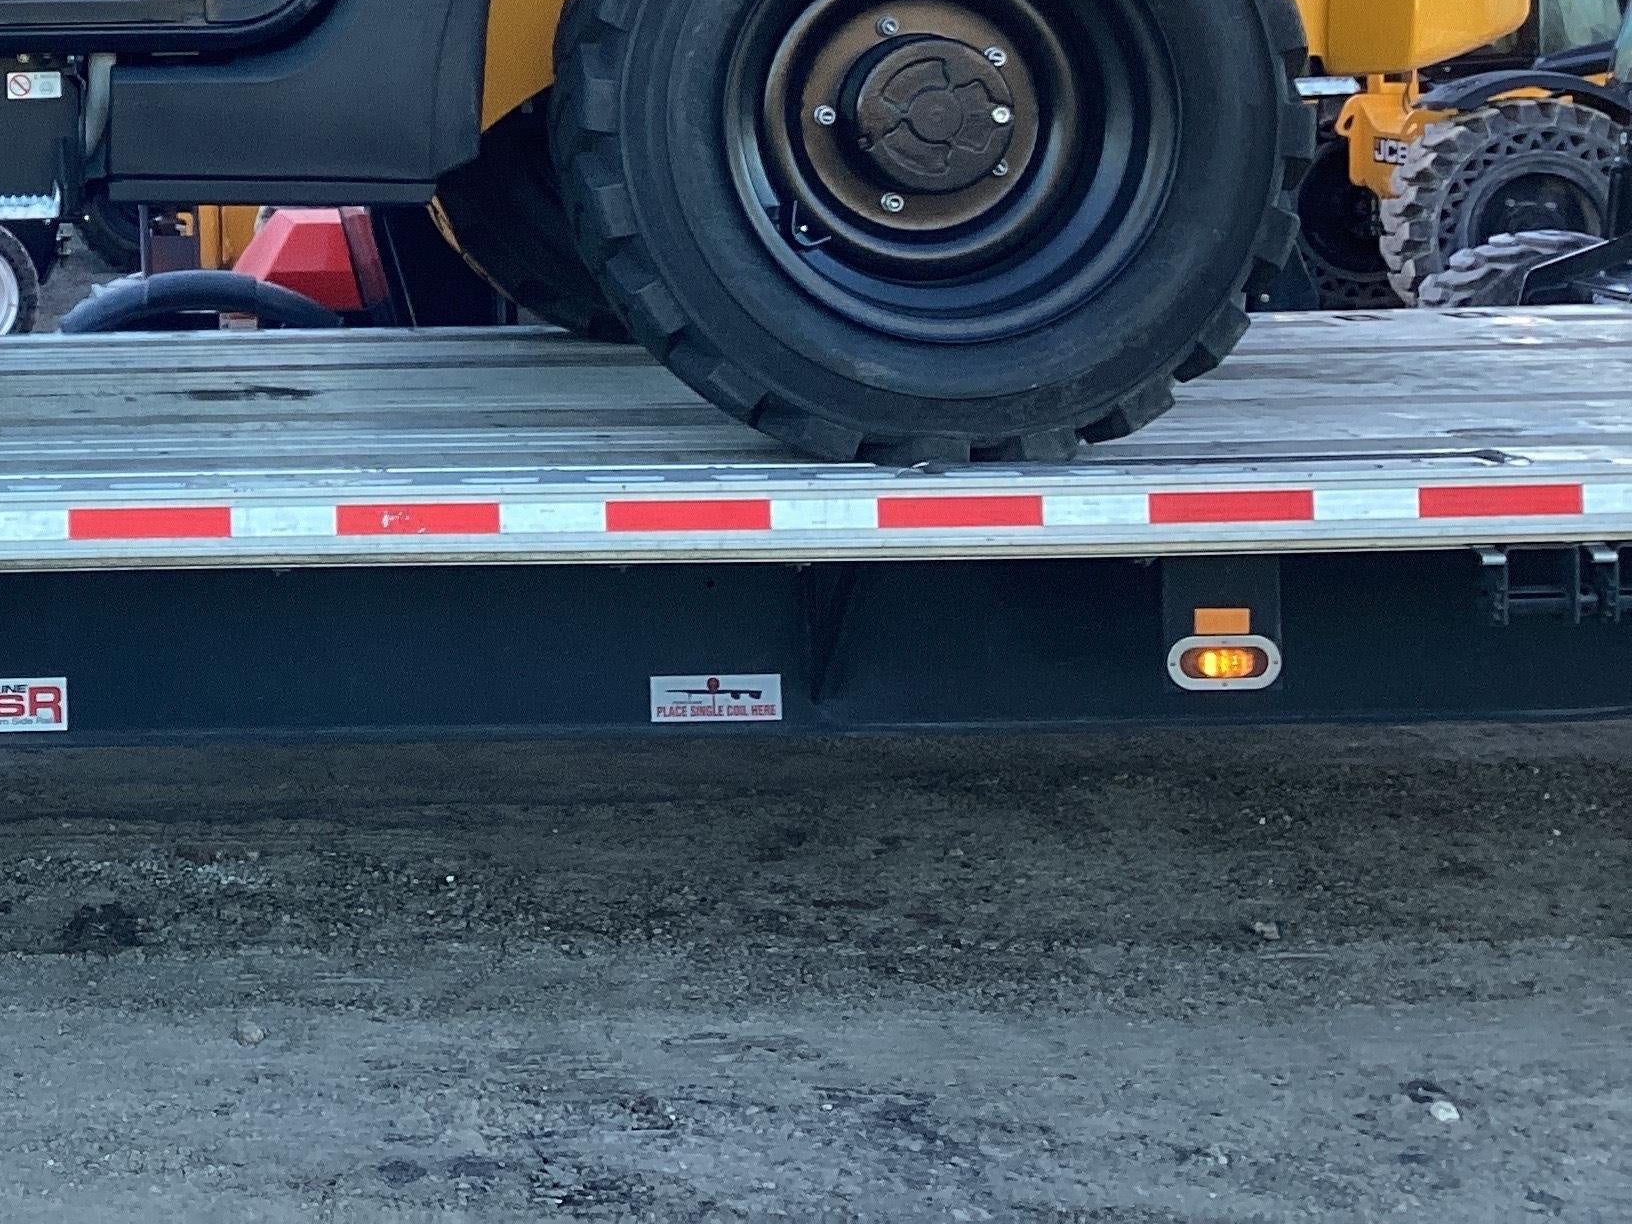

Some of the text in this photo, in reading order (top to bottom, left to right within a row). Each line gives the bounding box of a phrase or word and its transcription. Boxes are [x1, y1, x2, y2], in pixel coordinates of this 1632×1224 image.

[656, 706, 687, 717] PLACE
[690, 705, 725, 717] SINGLE
[751, 704, 777, 716] HERE
